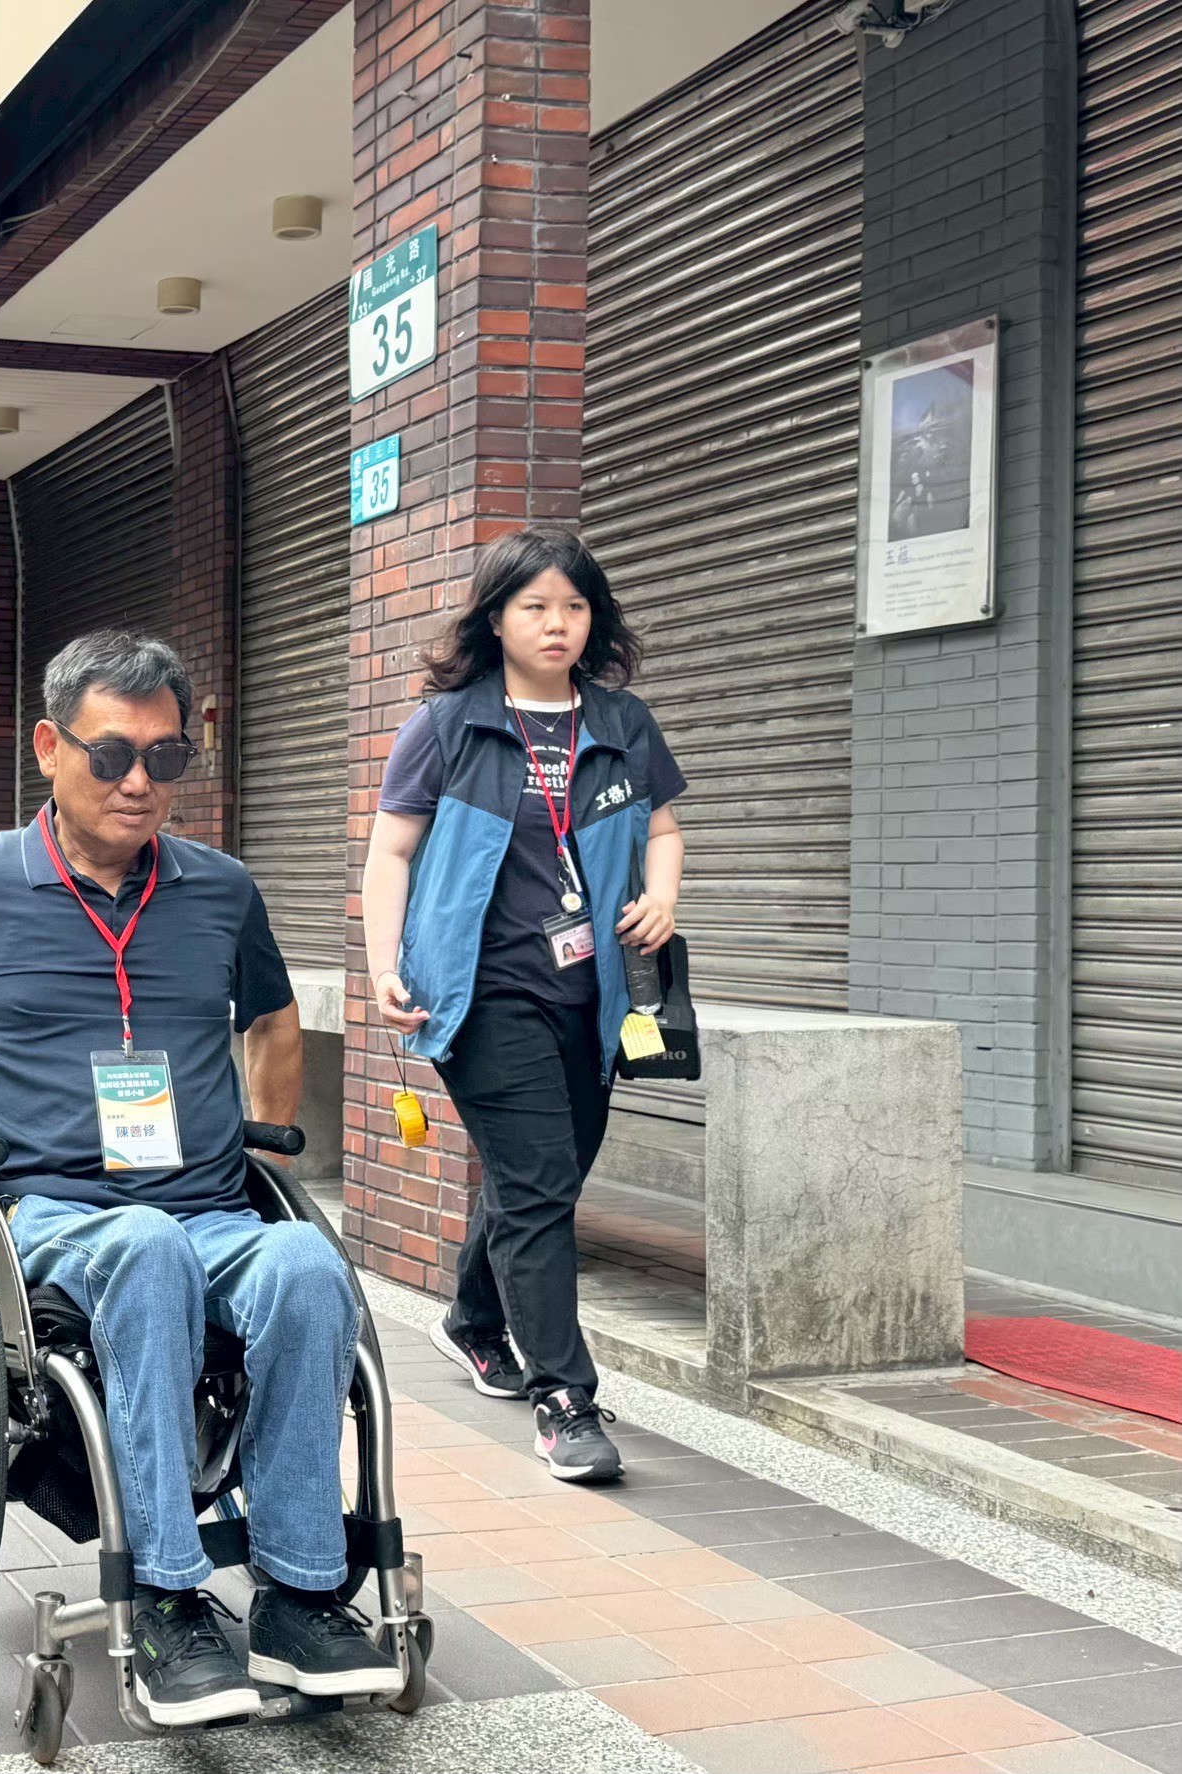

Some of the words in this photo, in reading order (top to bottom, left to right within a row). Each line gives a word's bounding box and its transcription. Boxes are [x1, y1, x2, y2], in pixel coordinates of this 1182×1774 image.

[362, 238, 420, 291] 國光路
[415, 264, 427, 284] 37
[371, 275, 400, 297] Guoguang
[357, 301, 368, 319] 33
[372, 298, 413, 377] 35
[370, 466, 390, 508] 35
